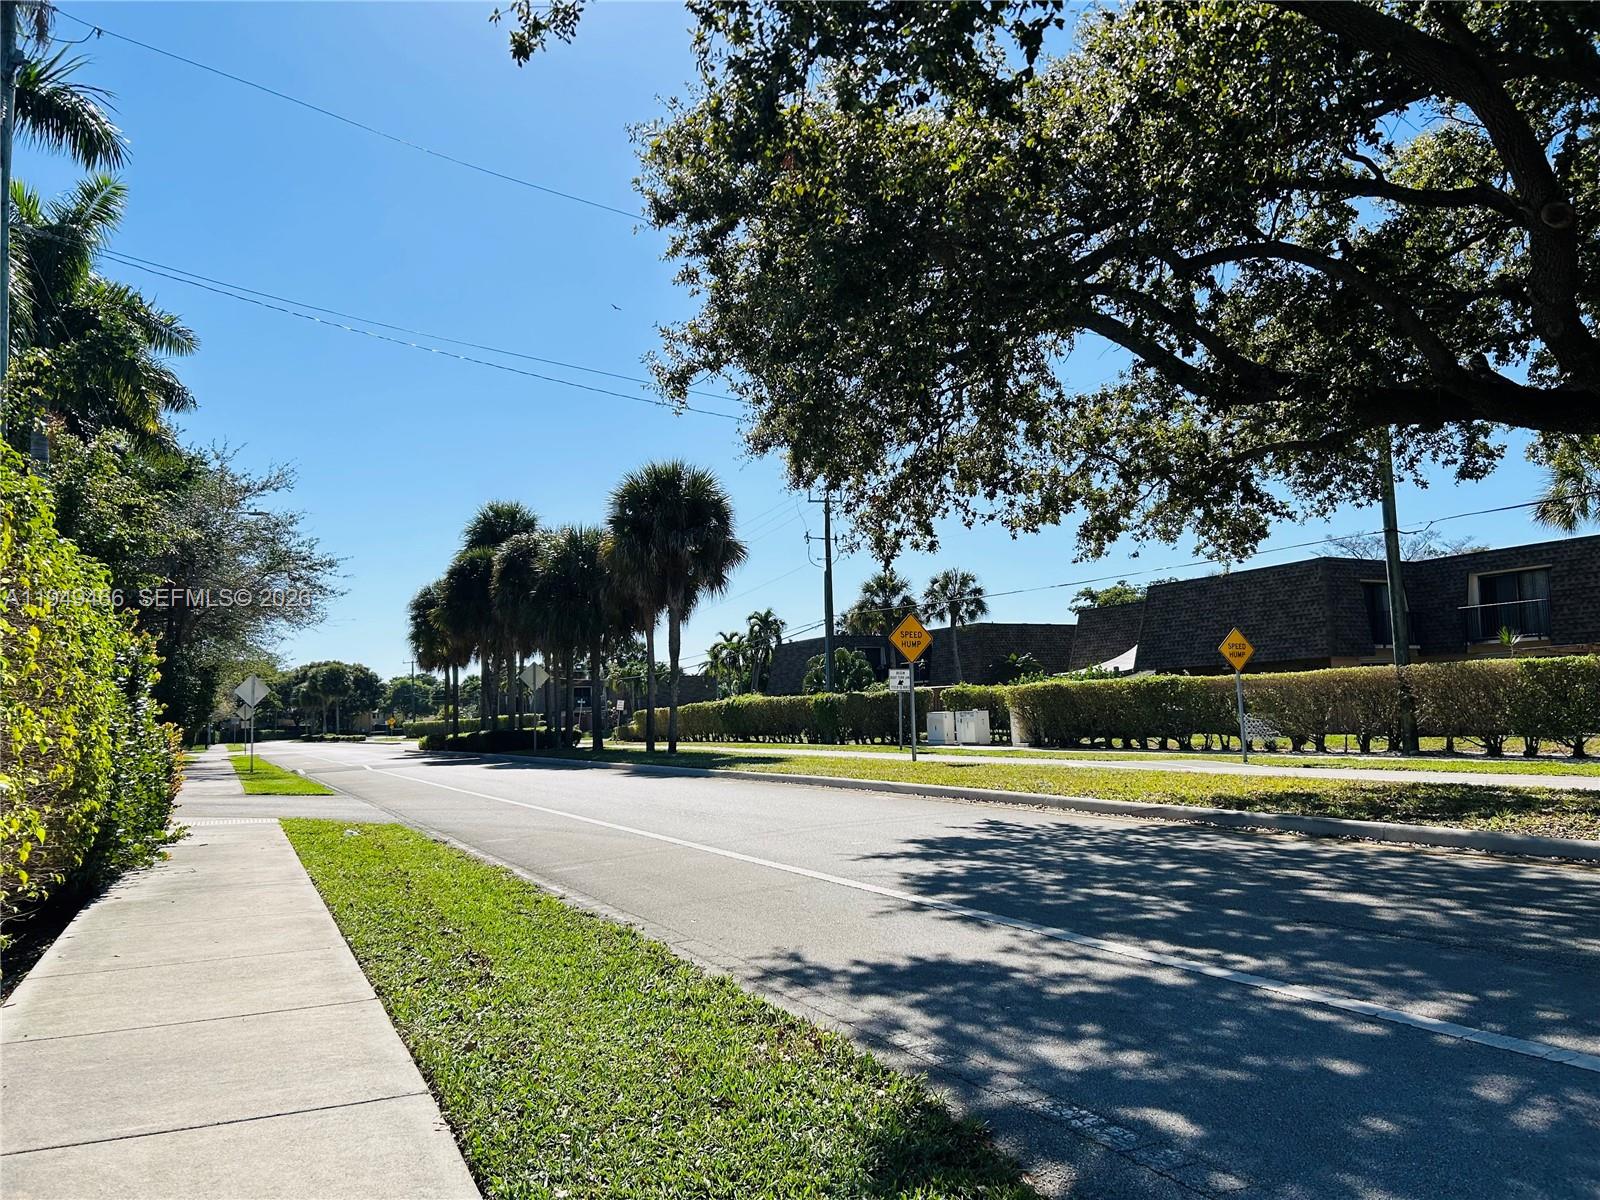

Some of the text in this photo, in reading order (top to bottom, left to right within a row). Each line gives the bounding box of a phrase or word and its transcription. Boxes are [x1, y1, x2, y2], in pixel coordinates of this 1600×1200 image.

[900, 630, 922, 639] SPEED
[901, 640, 921, 648] HUMP
[1227, 642, 1246, 650] SPEED
